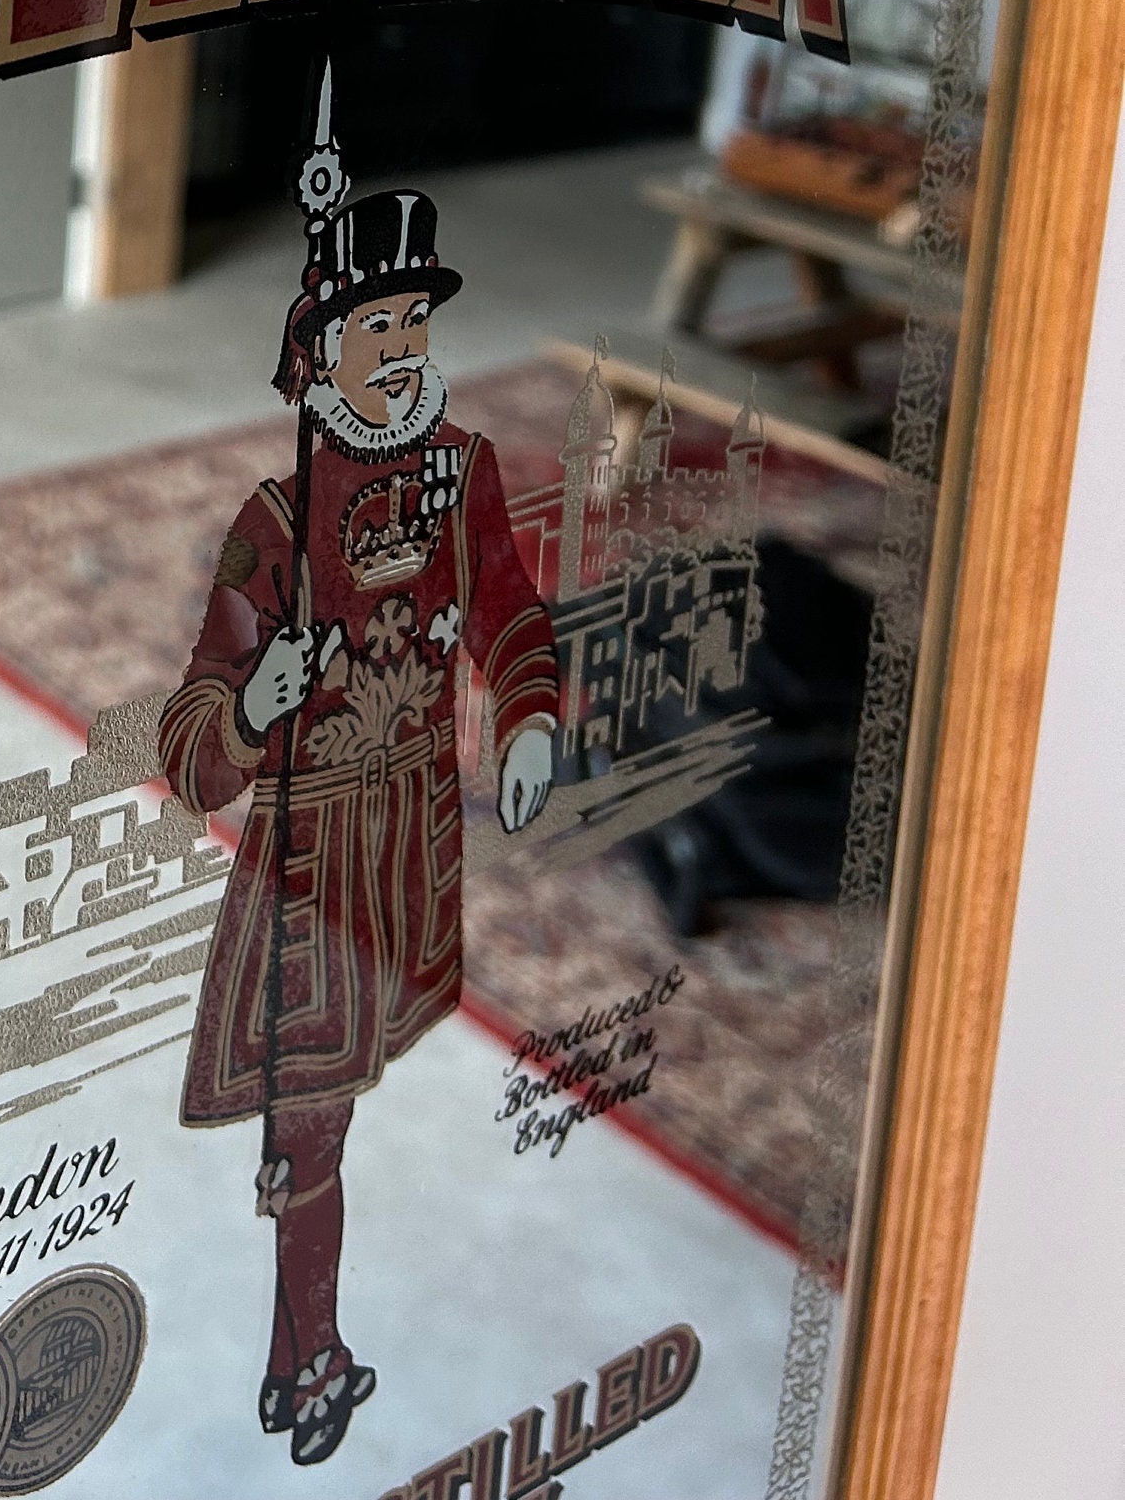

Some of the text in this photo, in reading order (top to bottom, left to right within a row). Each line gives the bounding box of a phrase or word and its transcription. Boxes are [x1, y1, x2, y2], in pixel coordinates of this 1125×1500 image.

[503, 964, 685, 1078] Produced &
[620, 1026, 658, 1062] in
[514, 1052, 659, 1158] England
